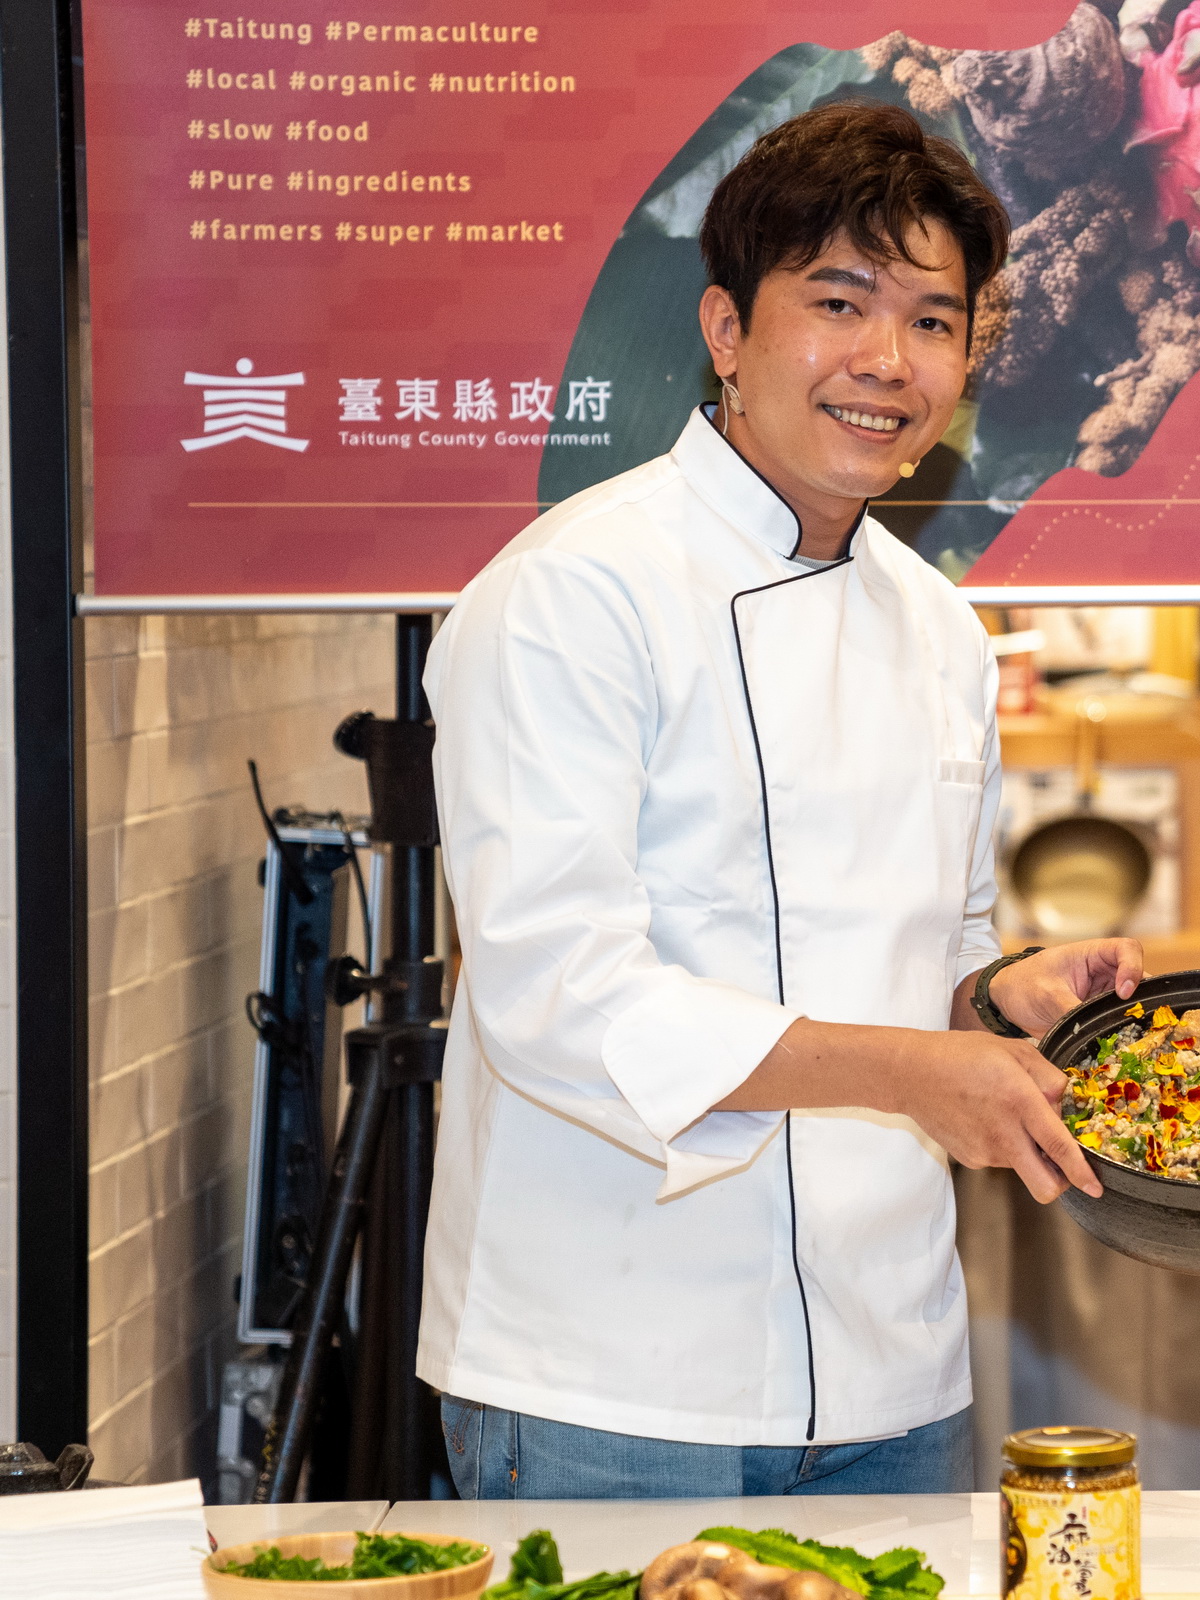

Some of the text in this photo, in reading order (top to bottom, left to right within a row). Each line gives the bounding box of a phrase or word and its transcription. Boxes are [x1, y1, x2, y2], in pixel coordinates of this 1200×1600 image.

[184, 16, 539, 46] #Taitung #Permaculture
[185, 67, 576, 97] #local #organic #nutrition
[187, 118, 369, 142] #slow #food
[188, 169, 472, 197] #Pure #ingredients
[189, 218, 564, 247] #farmers #super #market
[338, 375, 613, 423] 臺東縣政府
[338, 430, 612, 450] Taitung County Government
